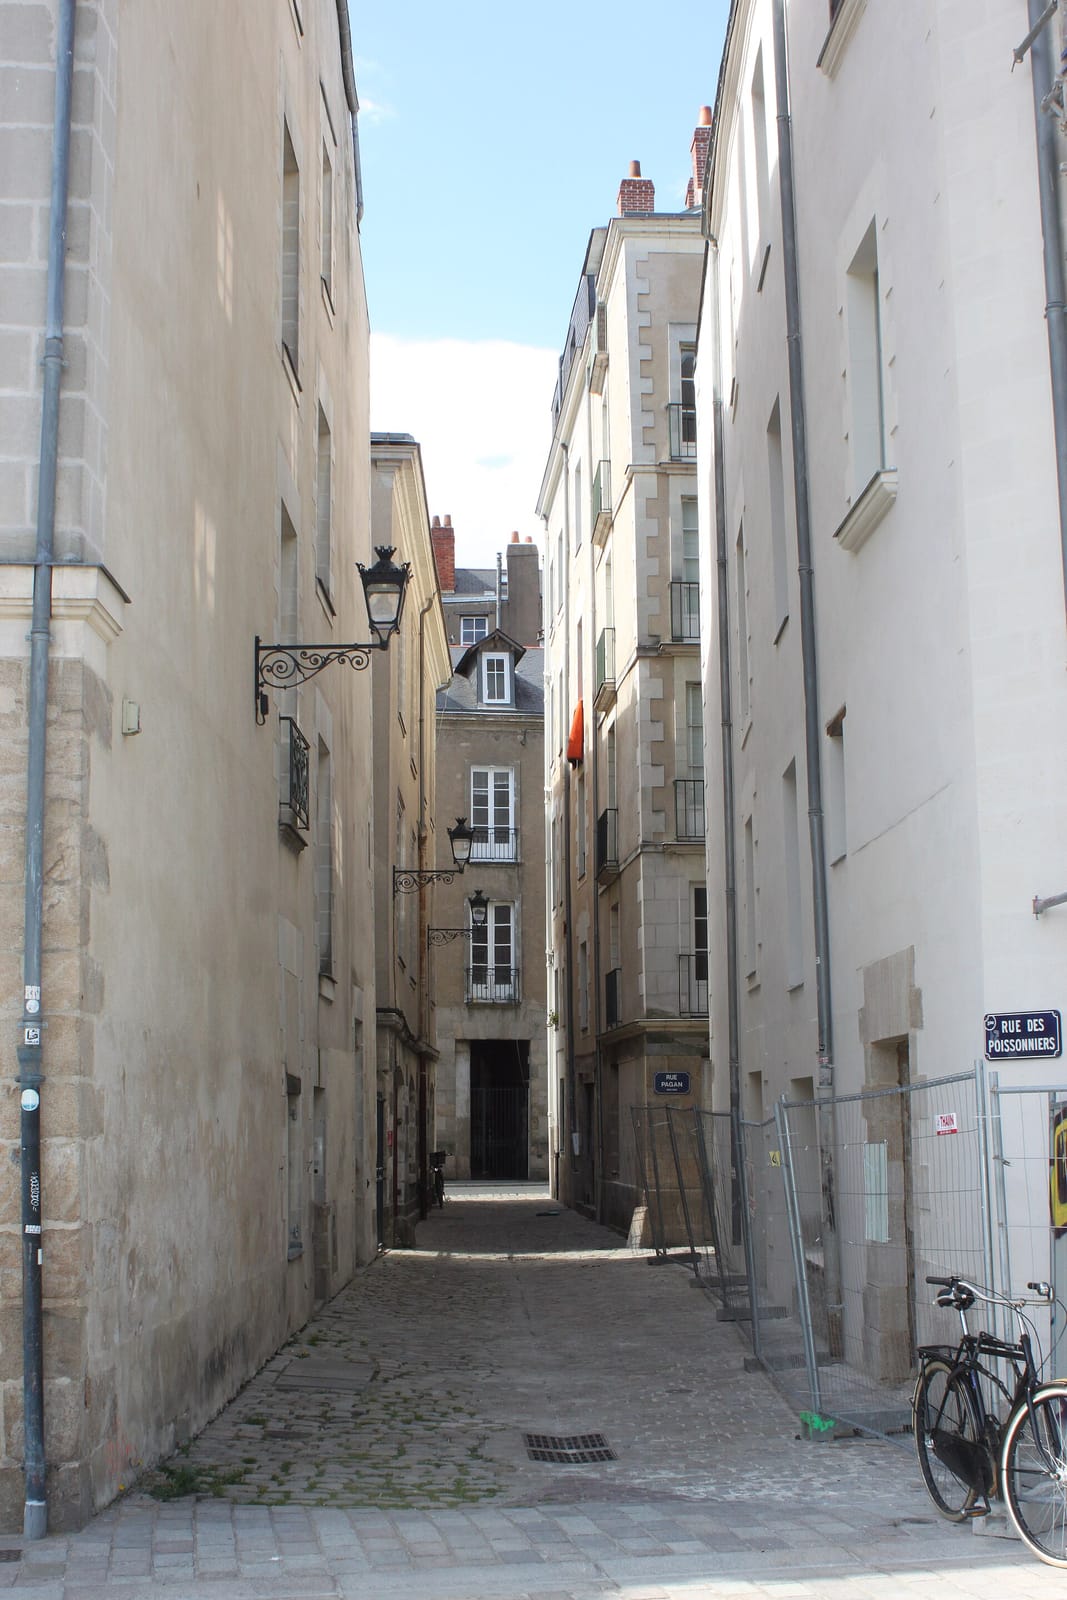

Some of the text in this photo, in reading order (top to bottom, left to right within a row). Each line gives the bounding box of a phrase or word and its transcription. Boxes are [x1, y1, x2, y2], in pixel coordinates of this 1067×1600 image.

[1001, 1020, 1021, 1034] RUE
[1027, 1018, 1045, 1032] DES
[988, 1037, 1055, 1053] POISSONNIERS
